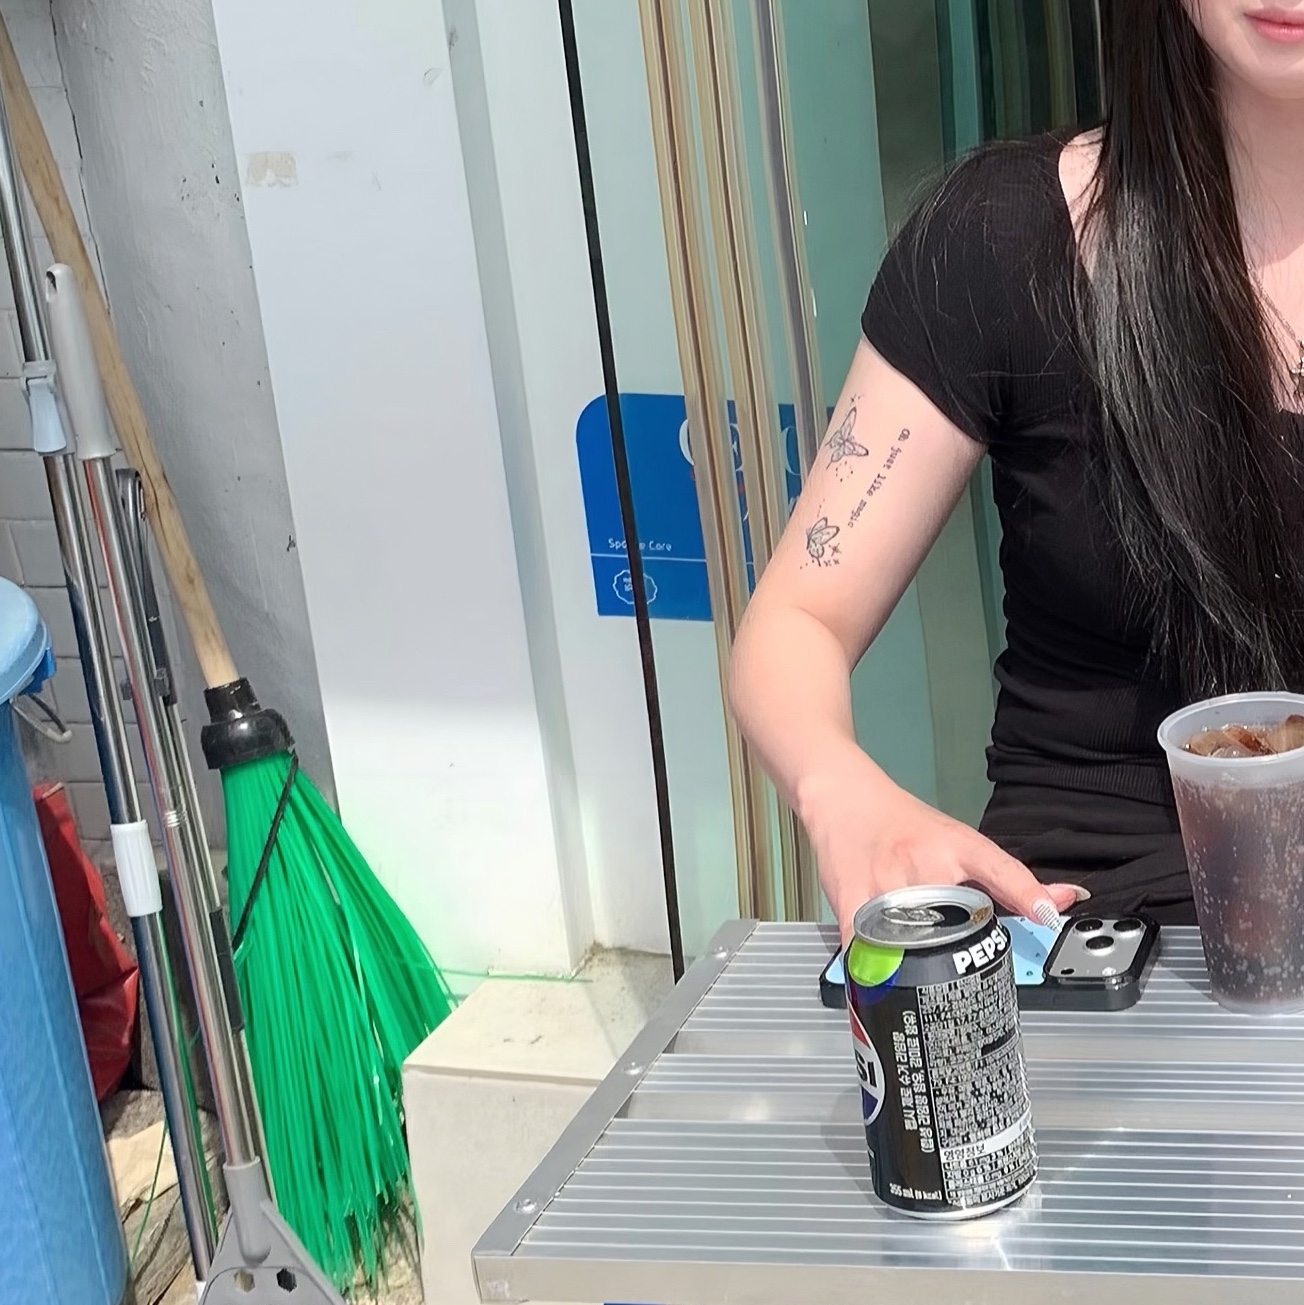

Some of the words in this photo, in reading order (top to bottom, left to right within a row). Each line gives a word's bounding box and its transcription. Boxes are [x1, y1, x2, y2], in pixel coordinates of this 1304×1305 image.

[883, 446, 902, 469] just
[867, 473, 886, 496] like
[952, 925, 1008, 975] PEPSI
[892, 1031, 908, 1062] 라임향
[897, 1064, 912, 1085] 슈거
